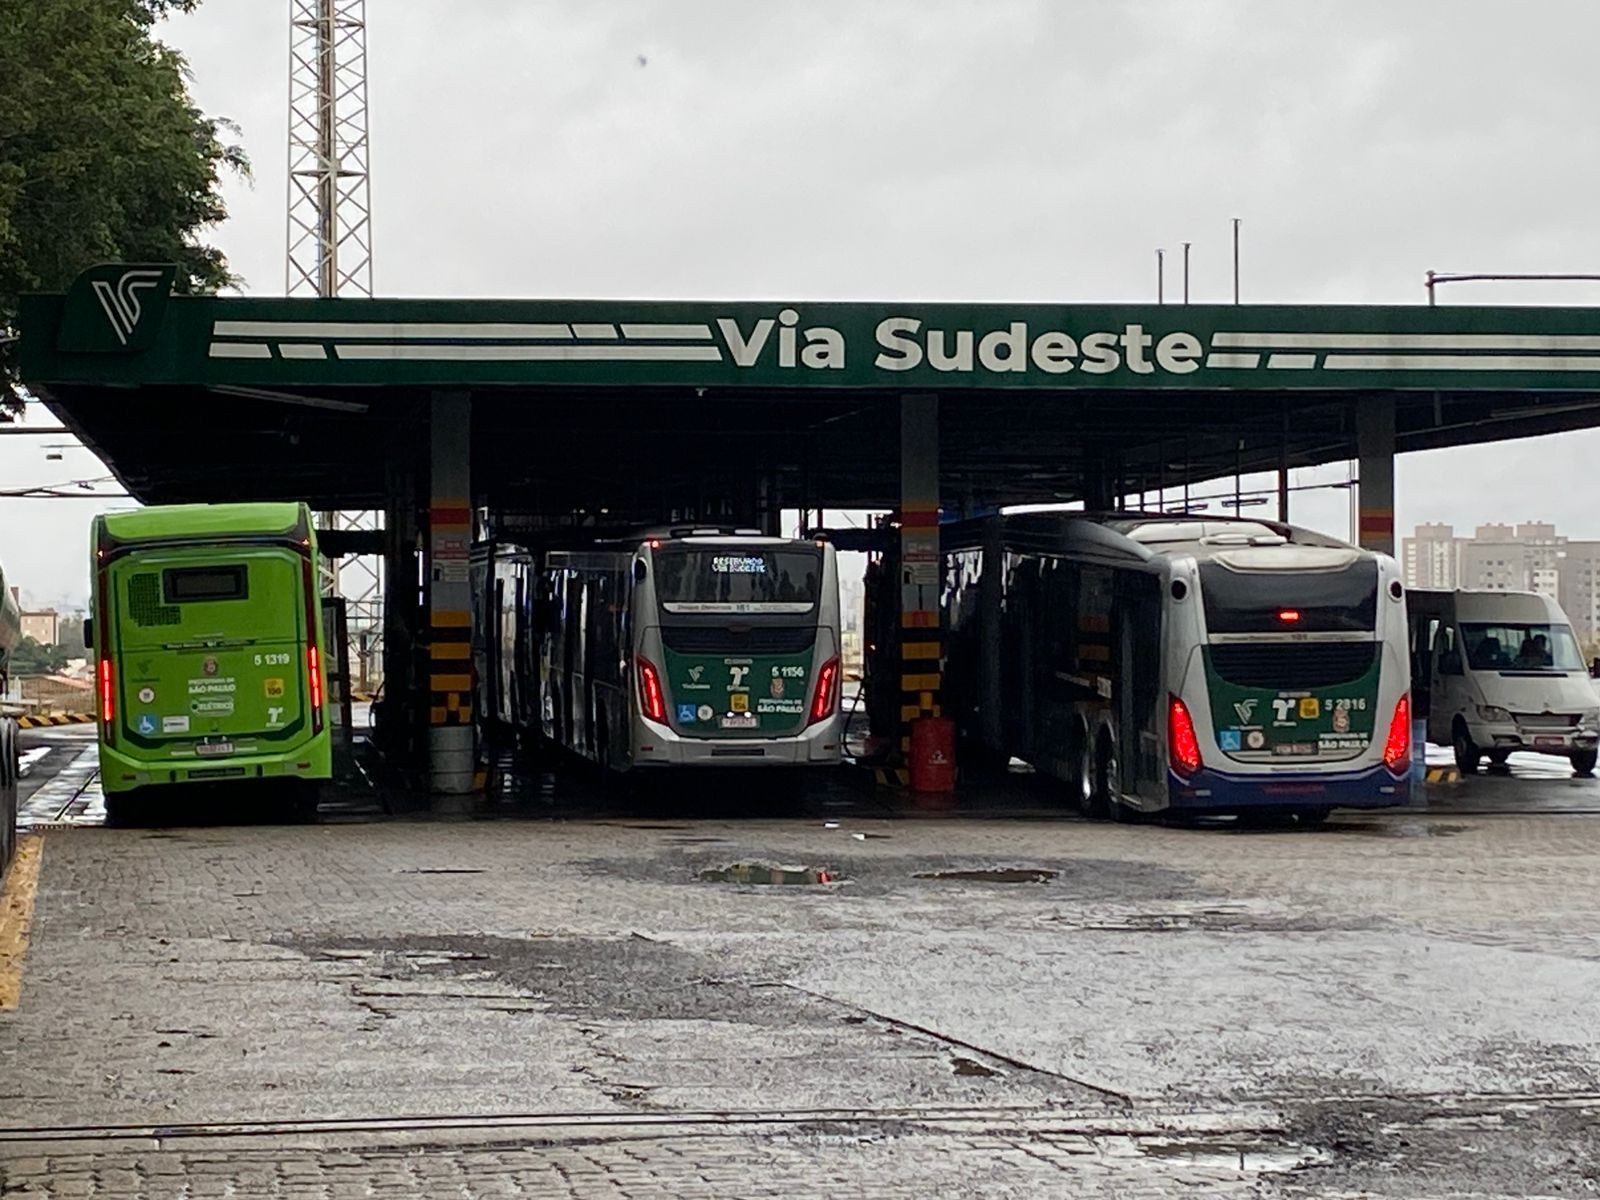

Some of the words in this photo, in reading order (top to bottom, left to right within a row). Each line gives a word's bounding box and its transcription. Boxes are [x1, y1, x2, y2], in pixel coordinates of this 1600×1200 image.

[716, 308, 846, 369] Via
[874, 316, 1203, 375] Sudeste
[264, 653, 290, 665] 1319
[776, 704, 804, 713] PAULO
